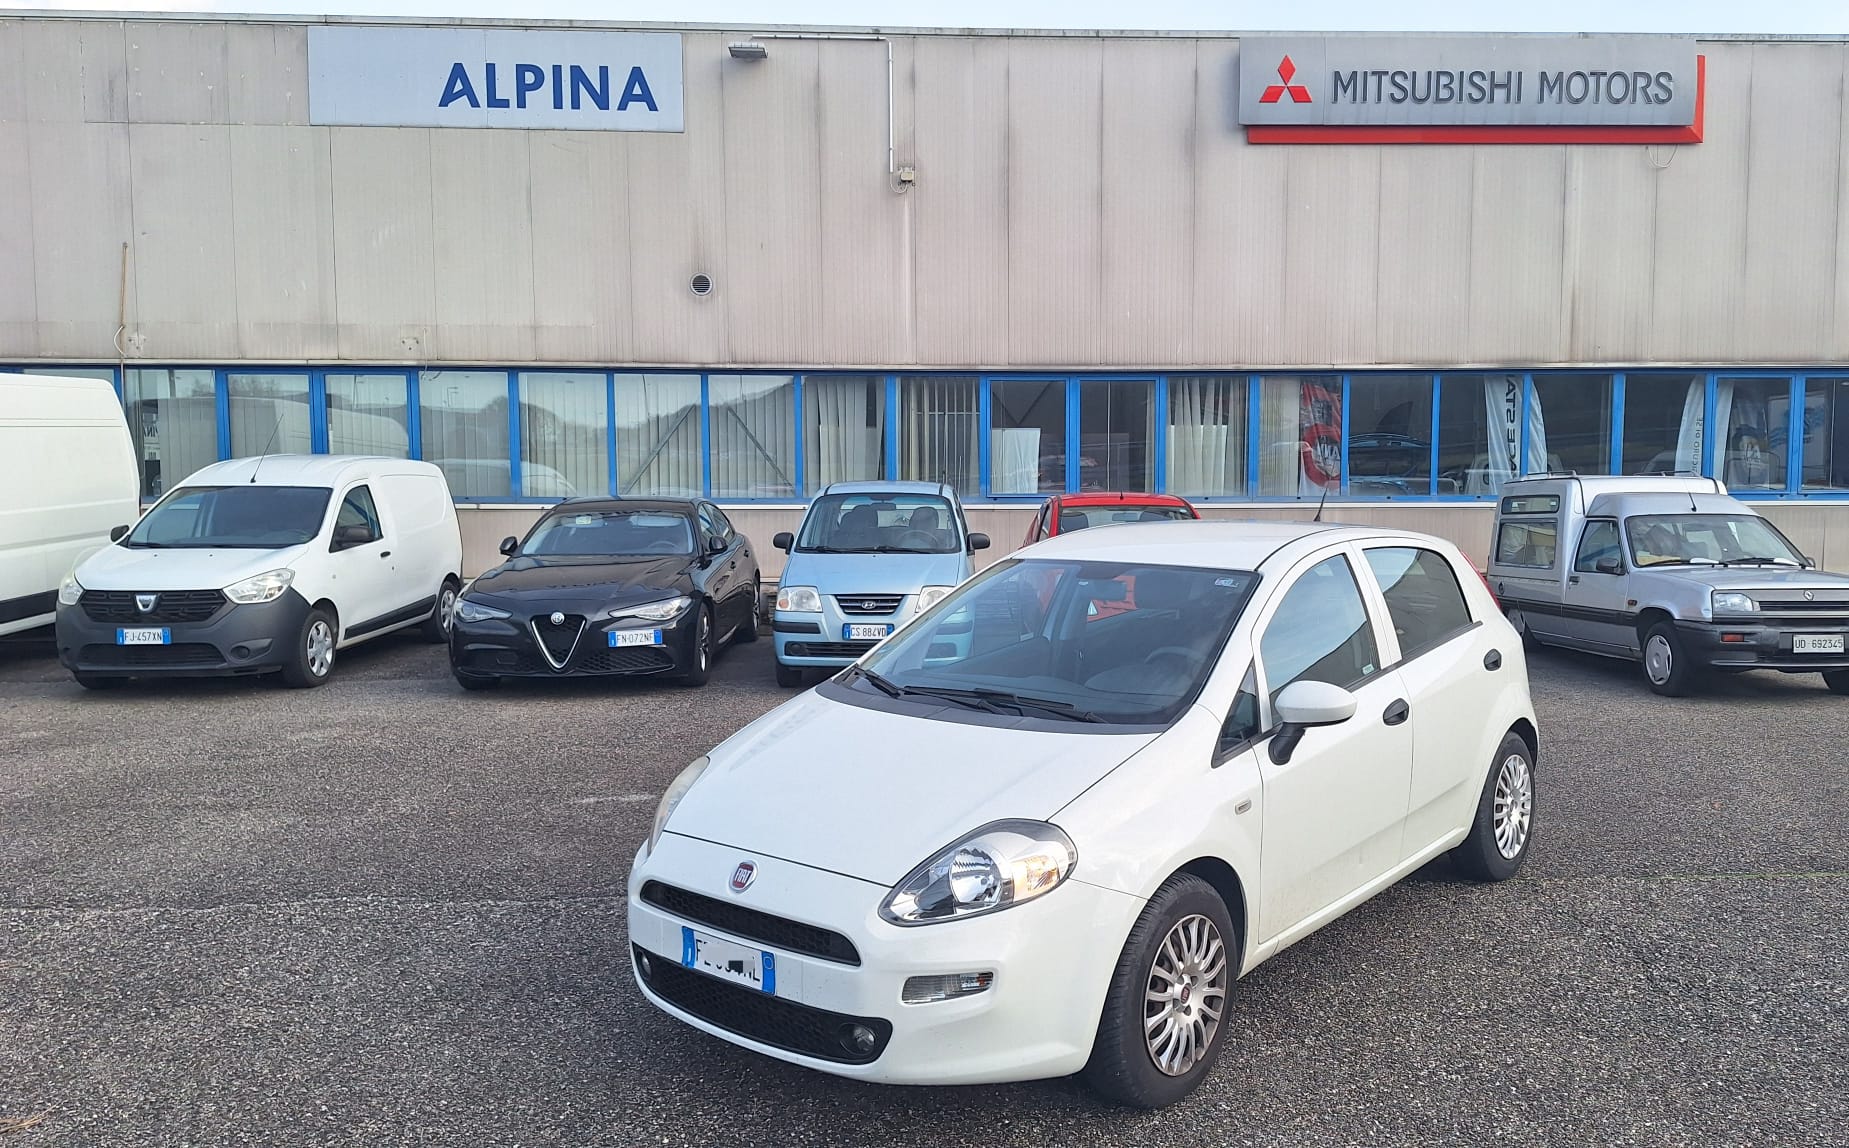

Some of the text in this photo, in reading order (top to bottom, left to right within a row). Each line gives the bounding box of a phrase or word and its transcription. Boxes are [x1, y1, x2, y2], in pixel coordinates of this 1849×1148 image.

[438, 62, 659, 112] ALPINA
[1331, 70, 1674, 105] MITSUBISHI MOTORS
[734, 868, 753, 884] FIAT
